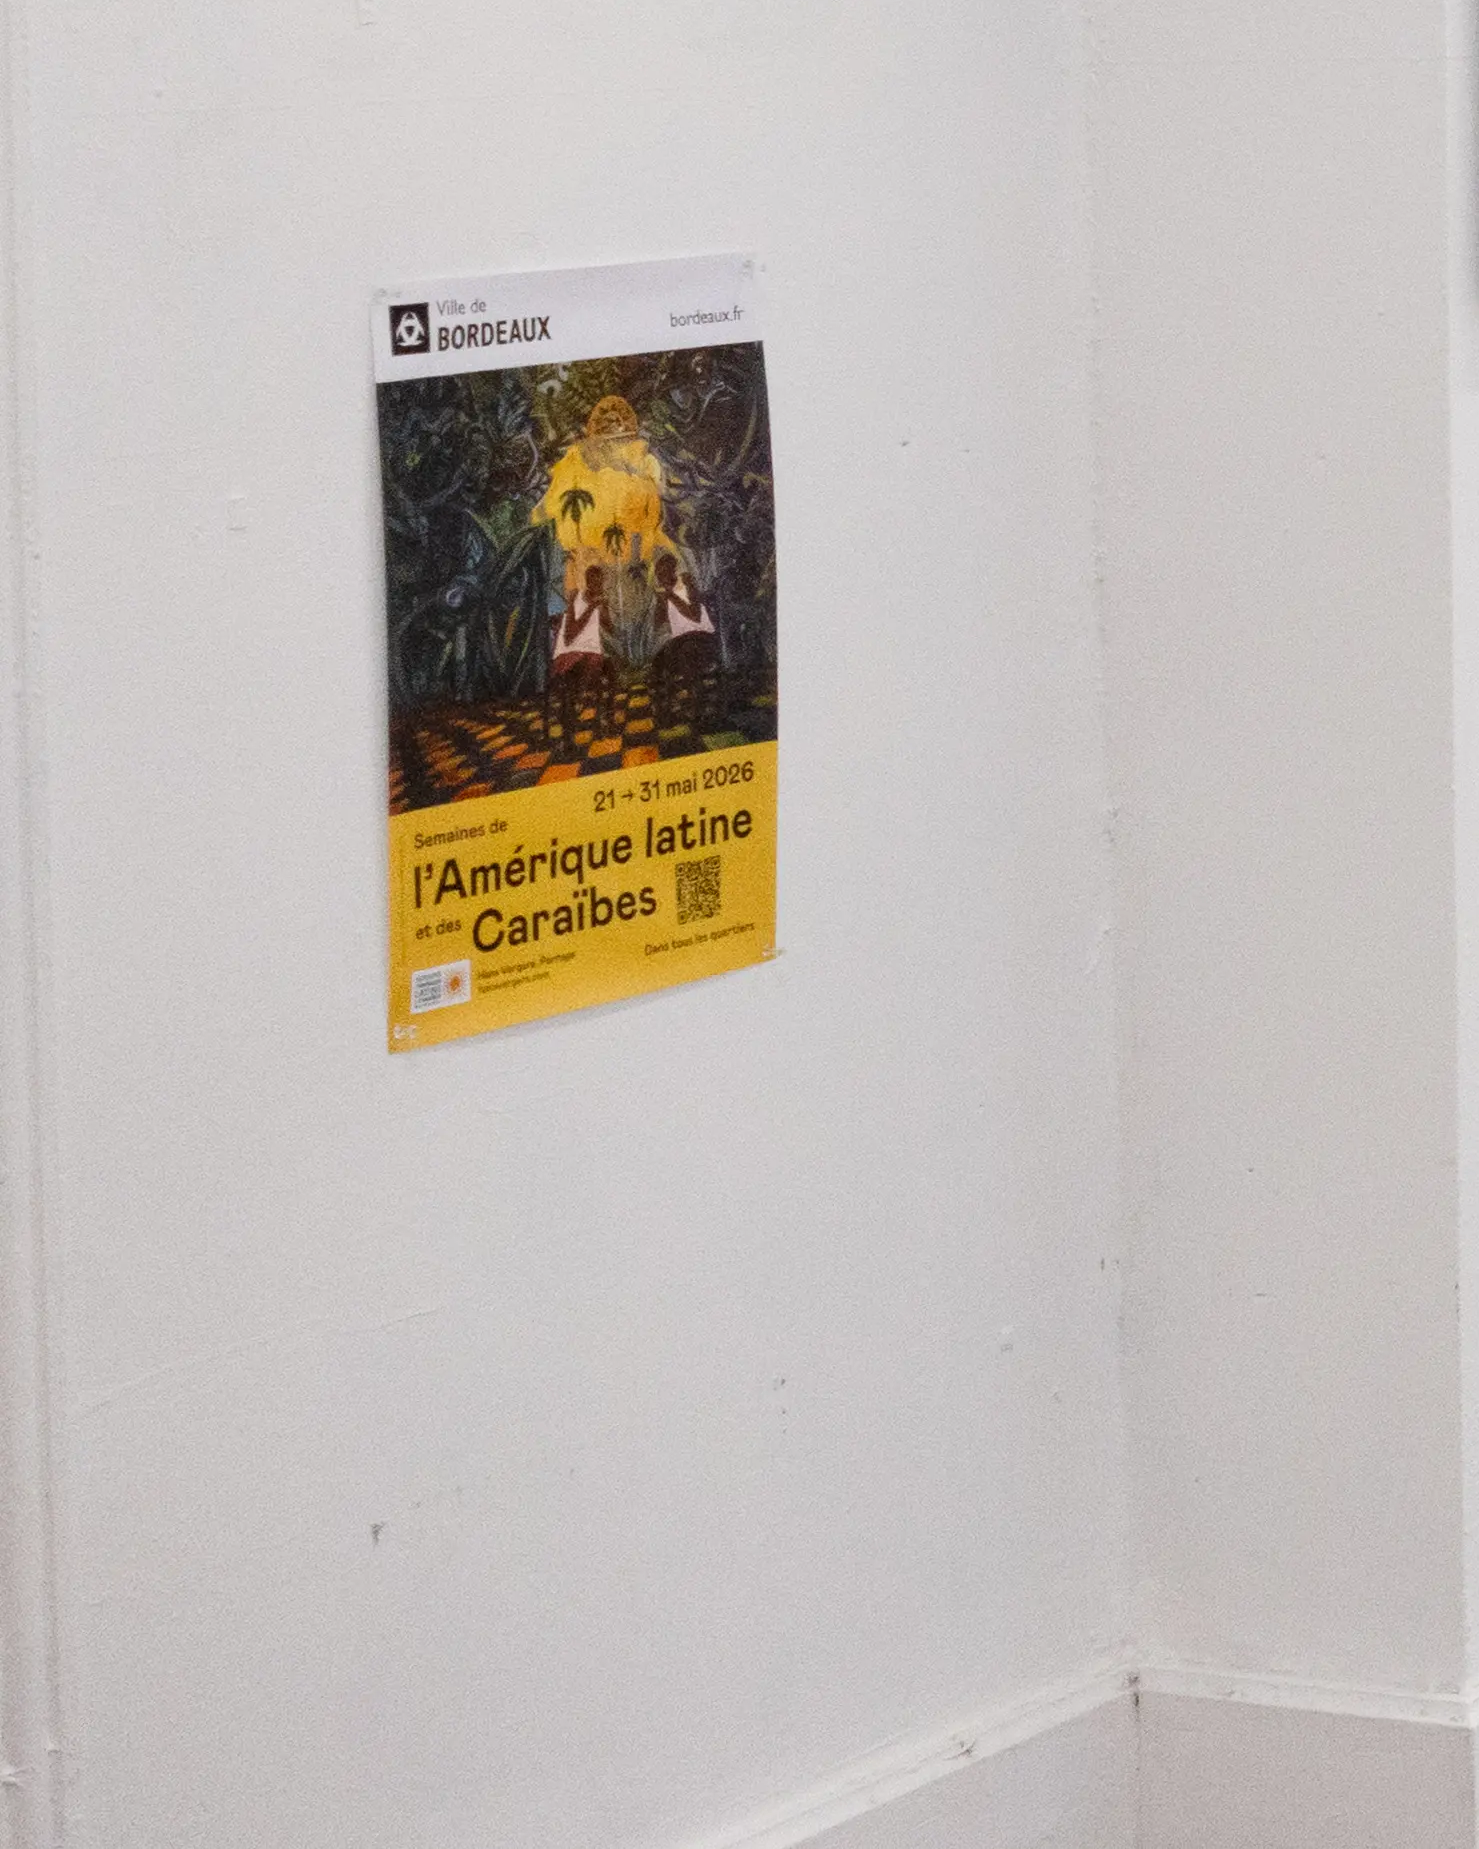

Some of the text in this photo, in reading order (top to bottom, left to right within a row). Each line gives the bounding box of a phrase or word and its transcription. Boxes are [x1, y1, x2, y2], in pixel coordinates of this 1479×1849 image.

[437, 299, 487, 317] Ville de
[669, 305, 746, 328] bordeaux.fr
[437, 315, 552, 352] BORDEAUX
[594, 761, 754, 813] 21 31 mai 2026
[414, 819, 508, 849] Semaines de
[646, 806, 753, 858] latine
[415, 919, 462, 941] et des
[472, 886, 658, 953] Caraïbes
[644, 942, 670, 957] Dans
[709, 922, 755, 941] quartiers
